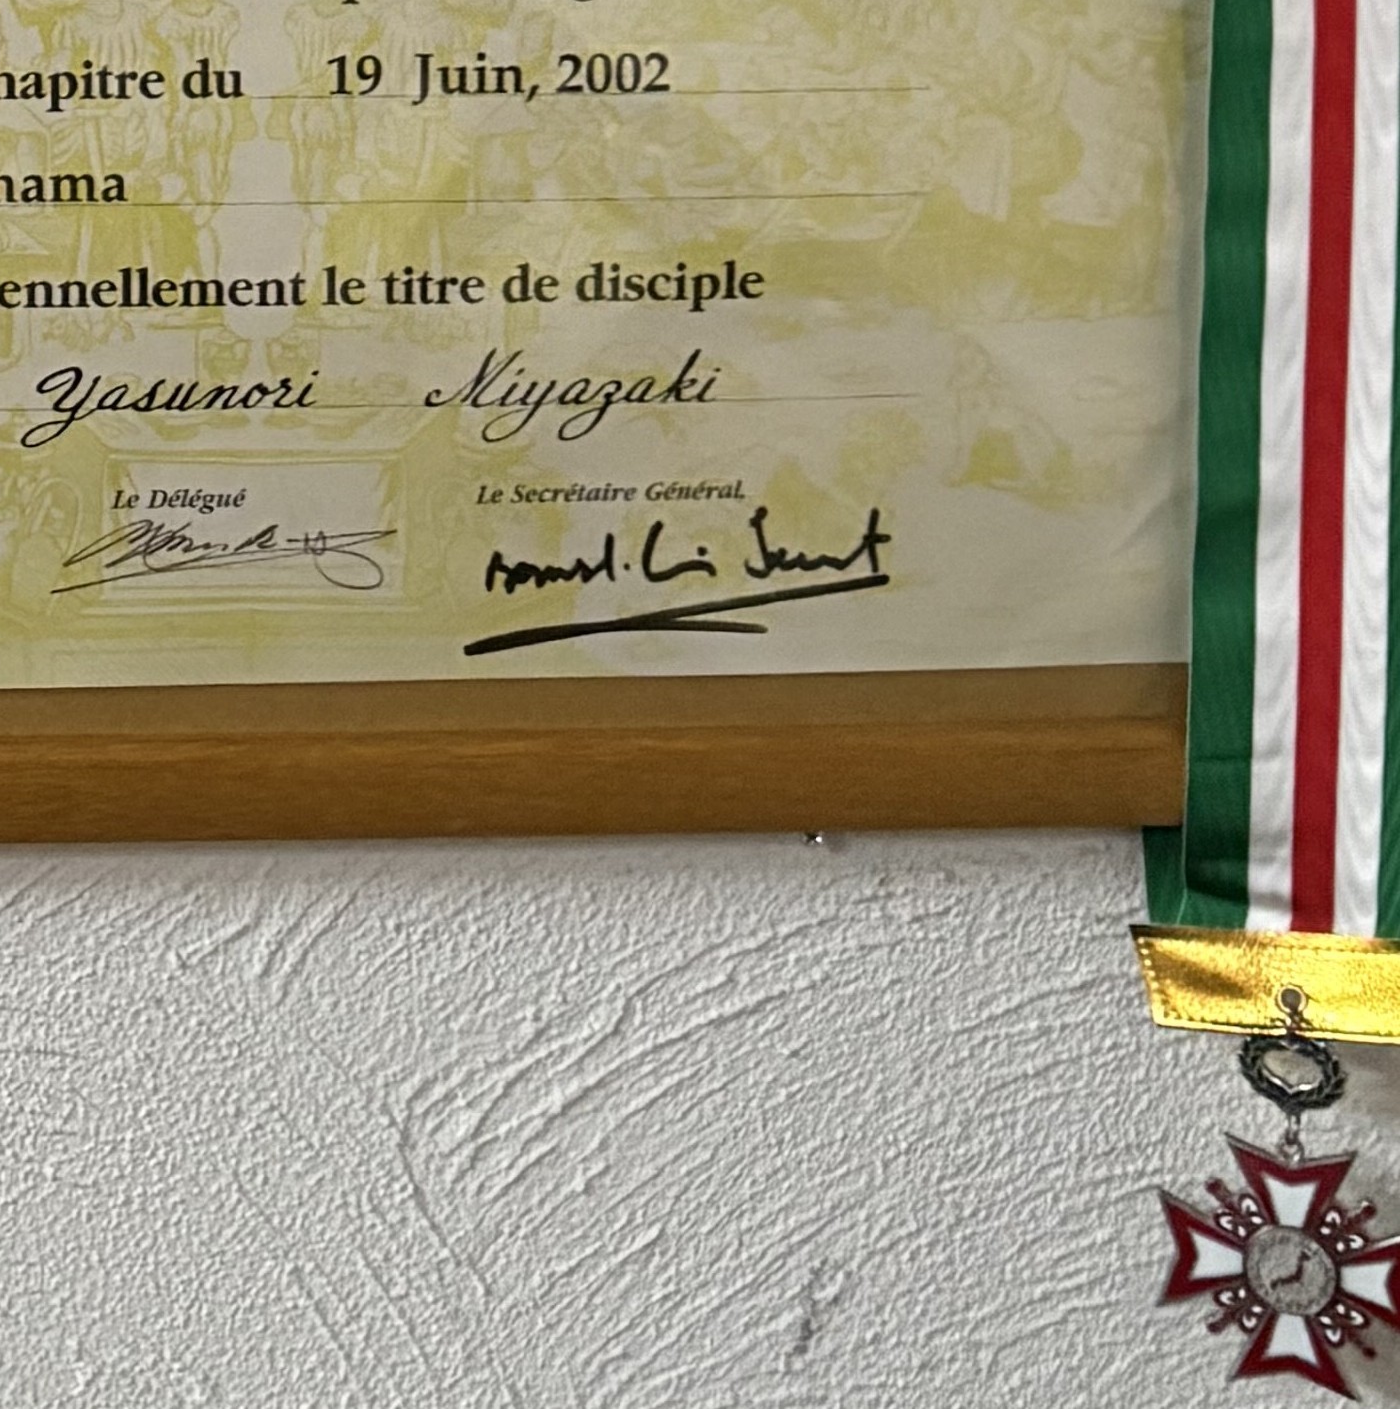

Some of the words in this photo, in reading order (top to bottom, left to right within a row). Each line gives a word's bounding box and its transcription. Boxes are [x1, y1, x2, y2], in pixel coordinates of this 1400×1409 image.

[181, 58, 245, 100] du
[326, 54, 383, 96] 19
[413, 51, 540, 105] Juin,
[555, 52, 671, 94] 2002
[320, 266, 367, 308] le
[382, 266, 486, 307] titre
[502, 264, 561, 305] de
[574, 260, 767, 315] disciple
[19, 364, 318, 449] Yasunori
[423, 348, 723, 443] Miyazaki
[110, 489, 142, 511] Le
[148, 486, 247, 513] Délégué
[475, 484, 504, 505] Le
[510, 482, 637, 504] Secrétaire
